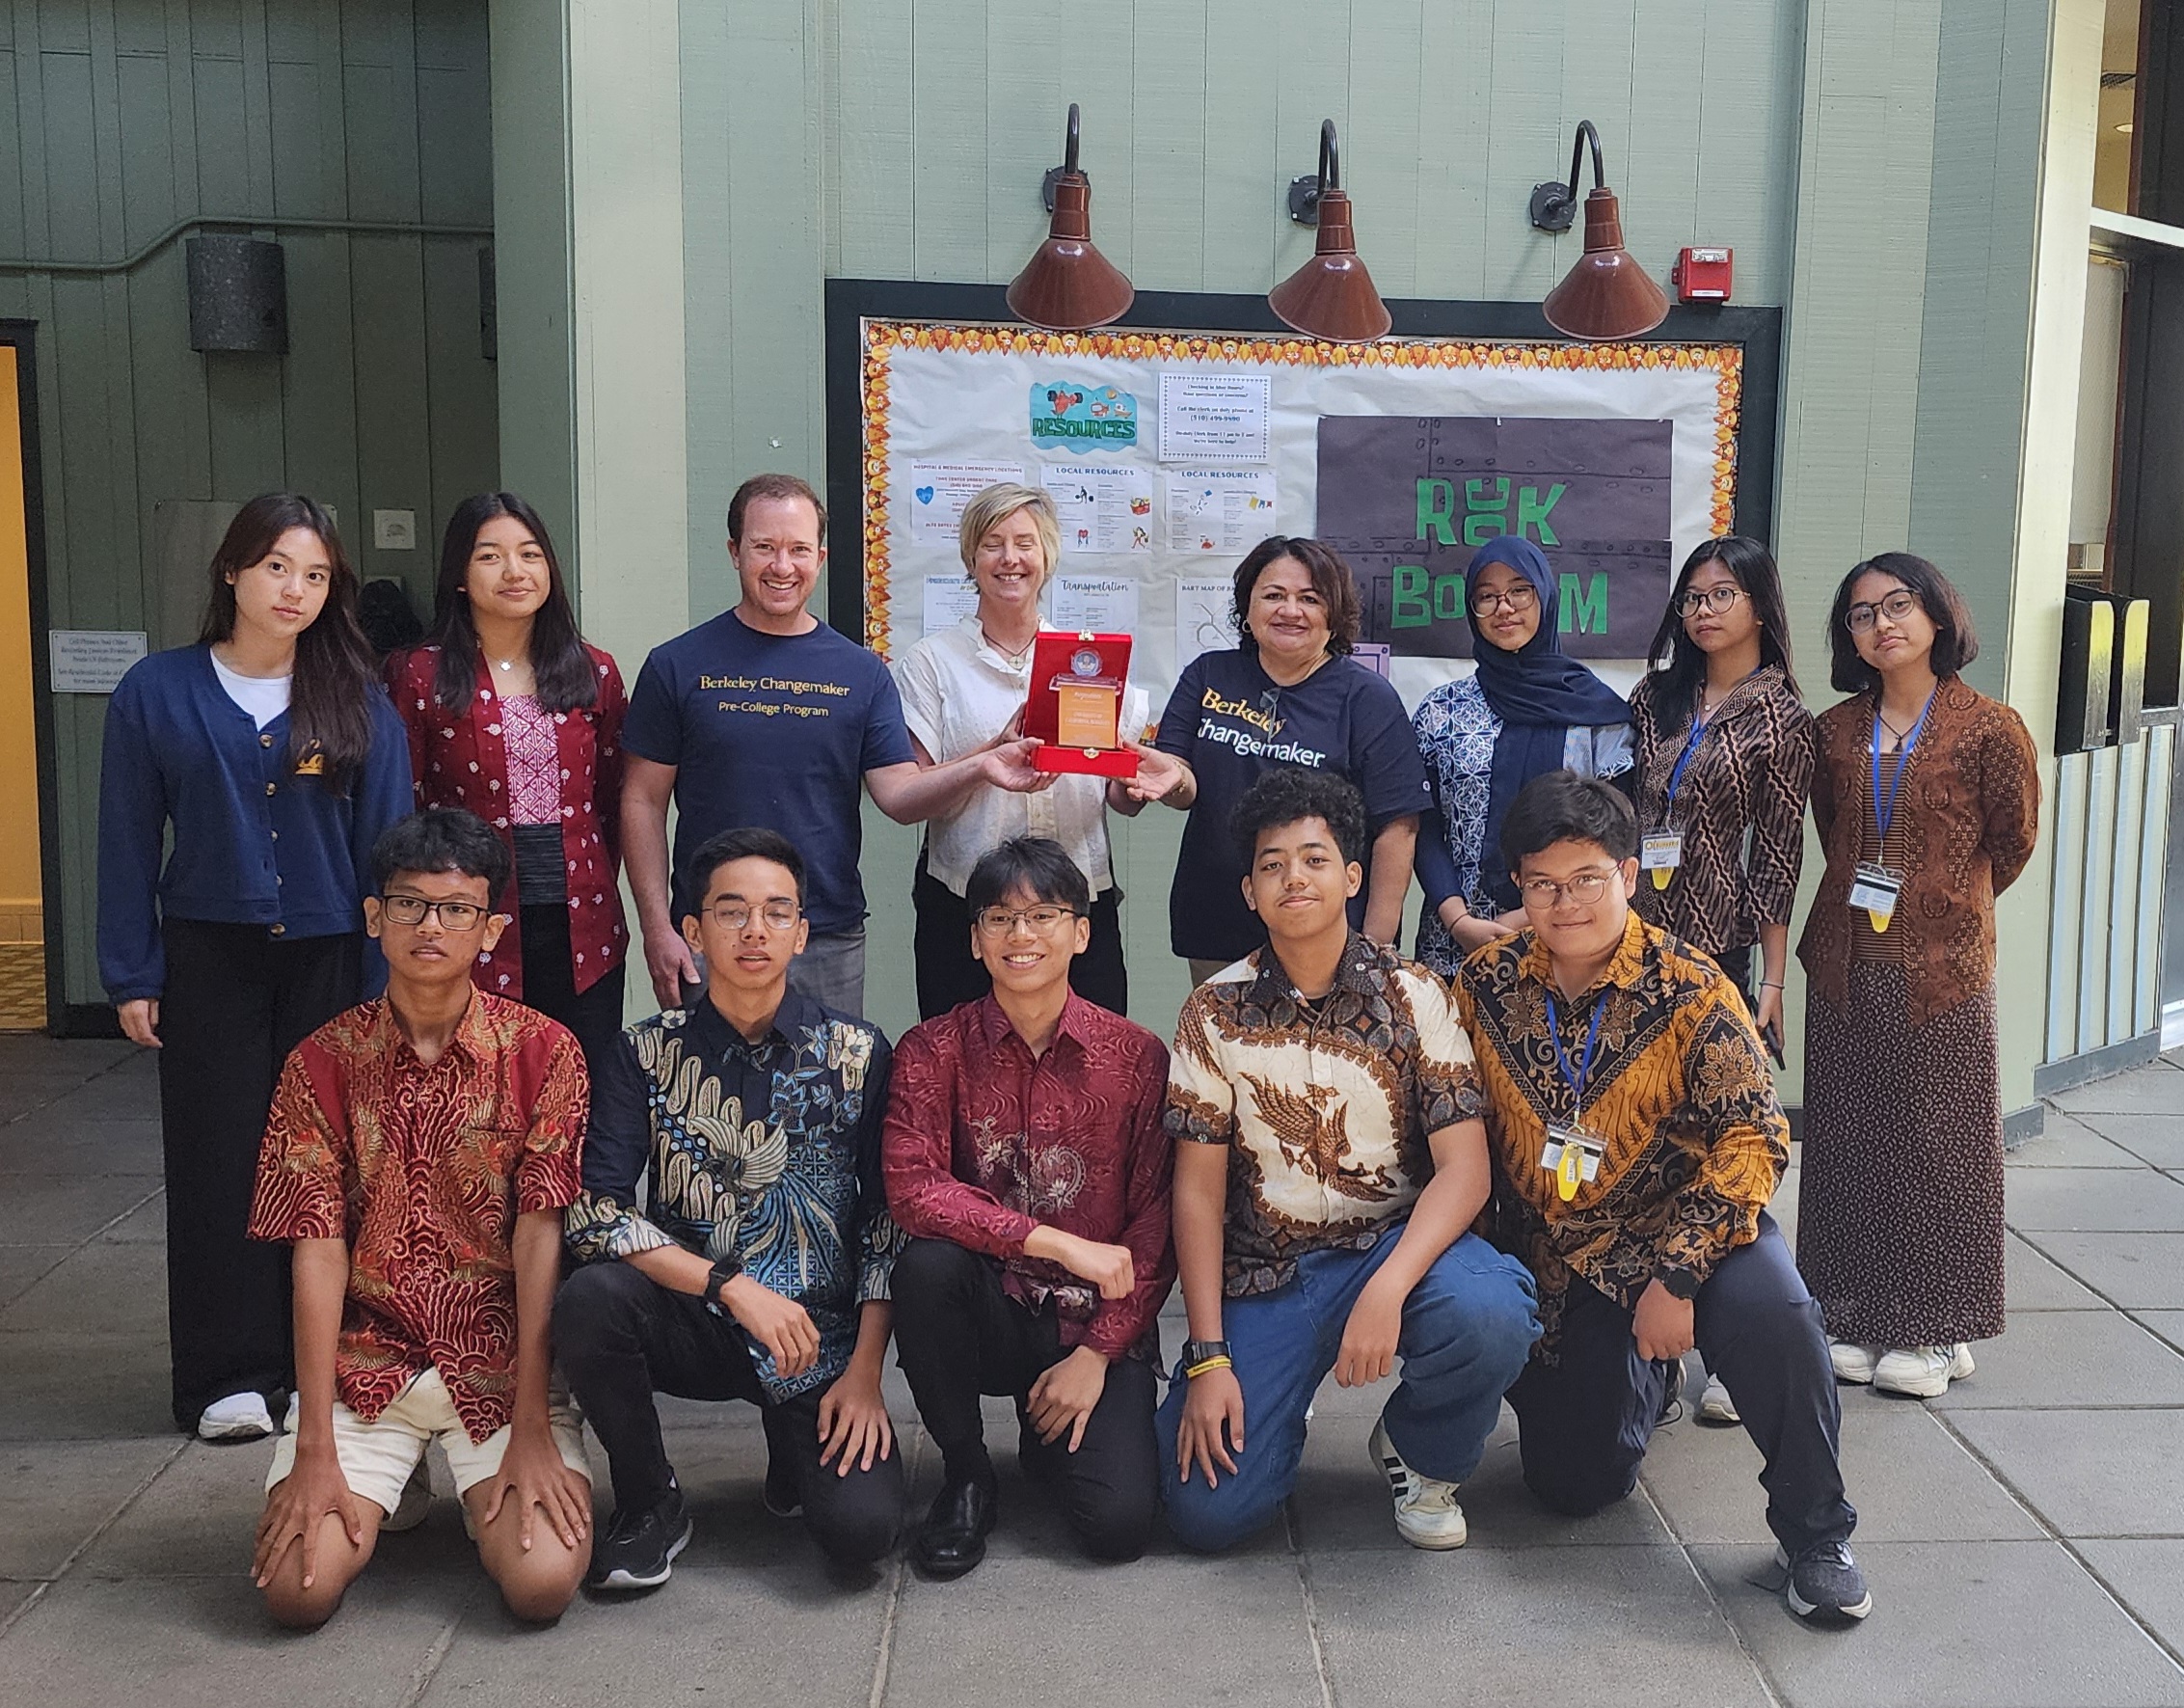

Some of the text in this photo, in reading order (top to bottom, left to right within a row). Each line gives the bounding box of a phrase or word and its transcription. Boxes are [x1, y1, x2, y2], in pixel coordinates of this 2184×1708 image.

[1032, 417, 1136, 440] RESOURCES
[1085, 468, 1135, 476] RESOURCES
[1060, 579, 1129, 593] Transportation
[1390, 565, 1608, 636] BOM
[699, 675, 850, 697] Berkeley Changemaker
[717, 701, 829, 718] Pre-College Program
[1201, 686, 1287, 739] Berkeley
